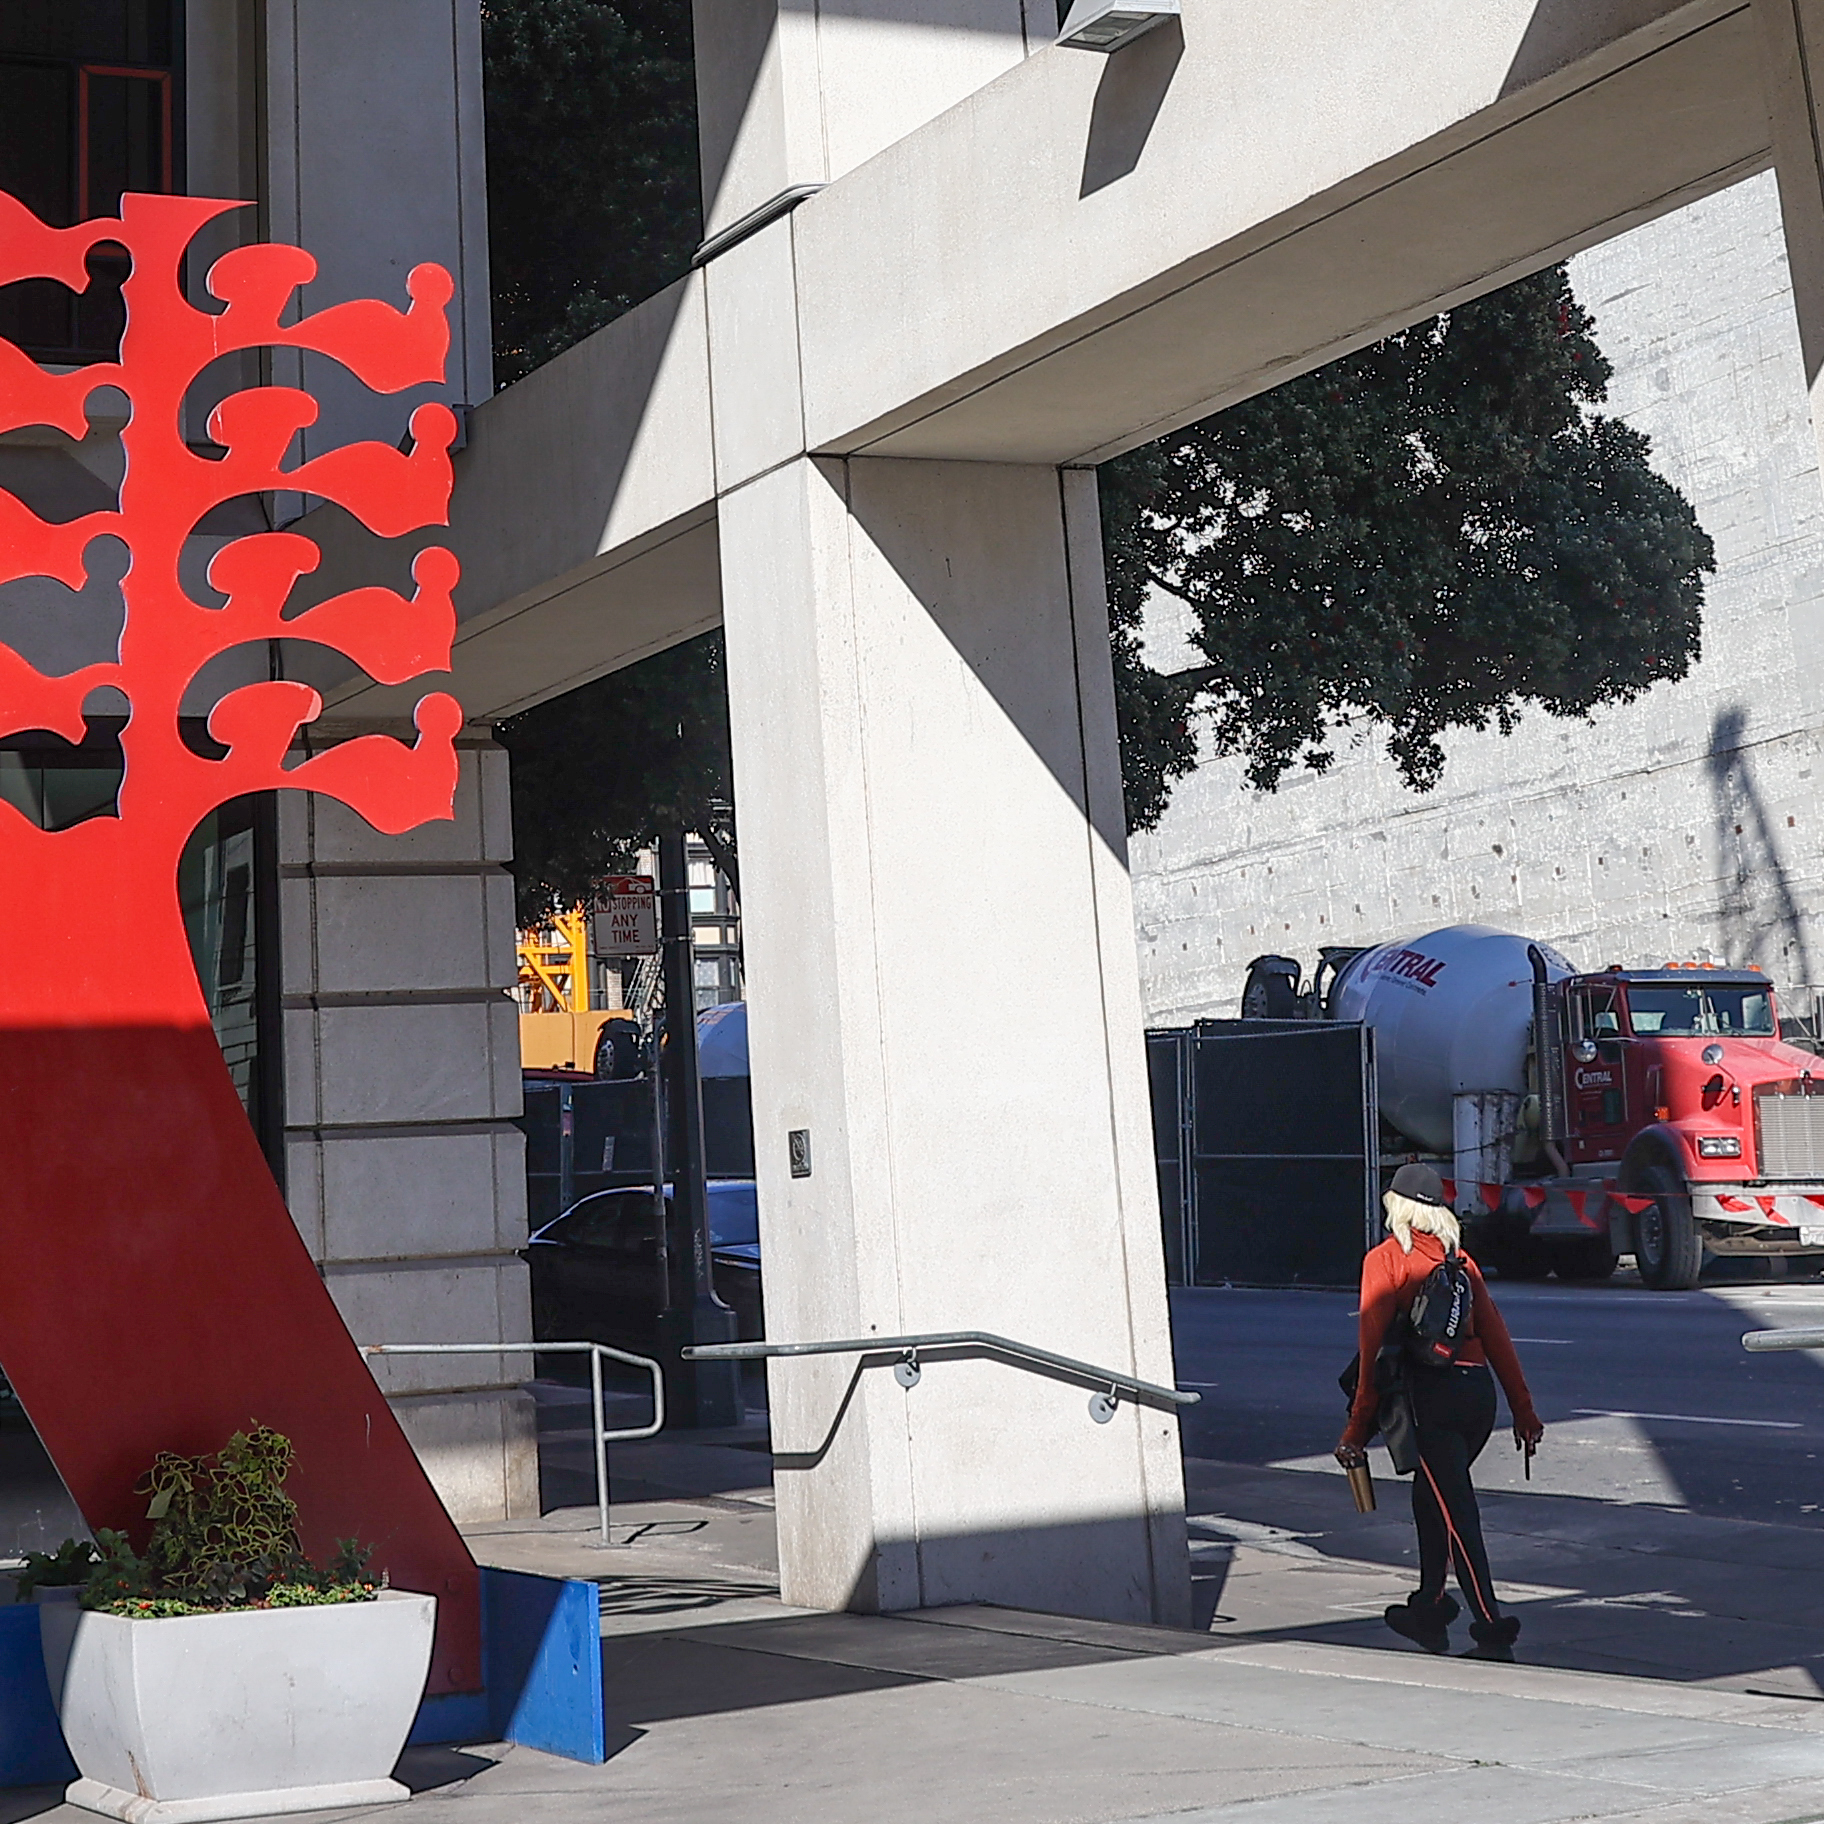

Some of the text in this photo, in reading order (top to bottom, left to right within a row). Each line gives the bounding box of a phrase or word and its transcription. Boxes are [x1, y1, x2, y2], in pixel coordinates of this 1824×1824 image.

[612, 896, 652, 911] STOPPING
[611, 914, 638, 928] ANY
[611, 929, 641, 943] TIME
[1575, 1067, 1613, 1090] CENTRAL
[1446, 1281, 1465, 1337] Supreme
